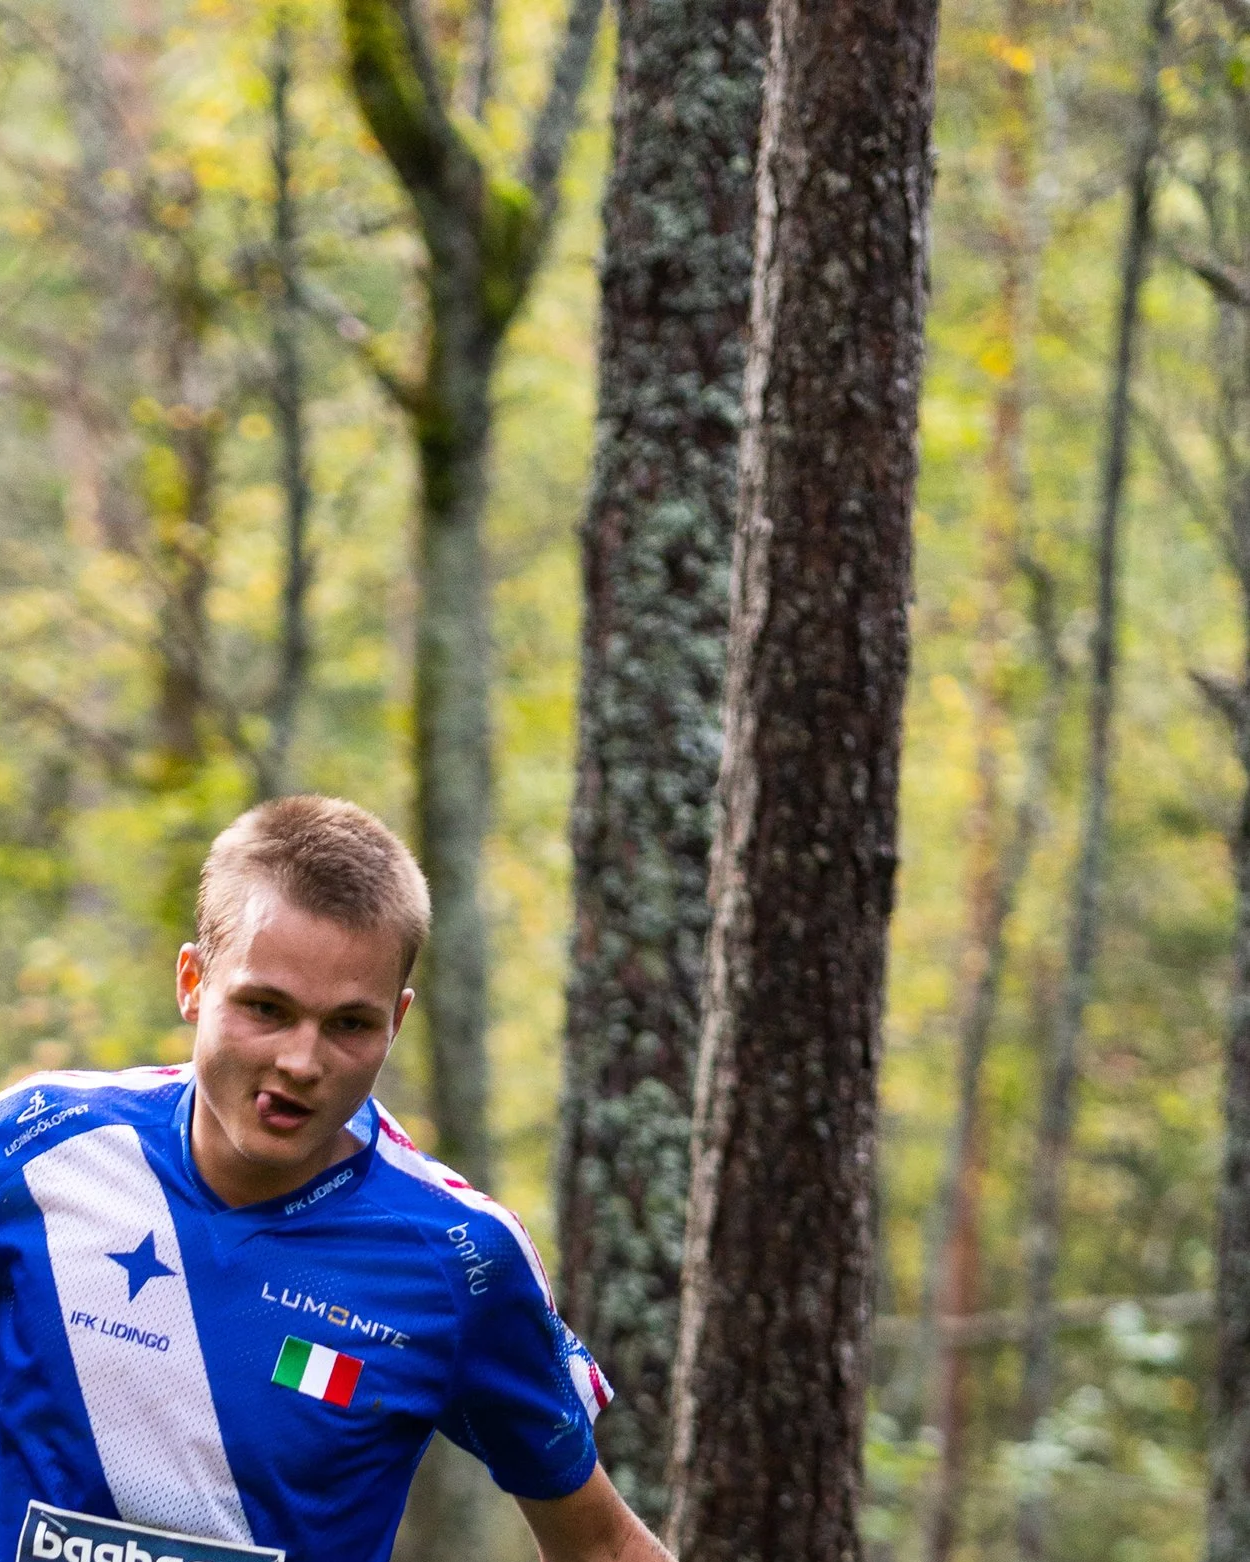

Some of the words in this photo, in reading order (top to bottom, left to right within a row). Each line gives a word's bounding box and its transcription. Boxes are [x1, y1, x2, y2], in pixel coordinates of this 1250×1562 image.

[285, 1197, 306, 1216] IFK
[70, 1310, 98, 1330] IFK
[261, 1281, 411, 1350] LUMONITE
